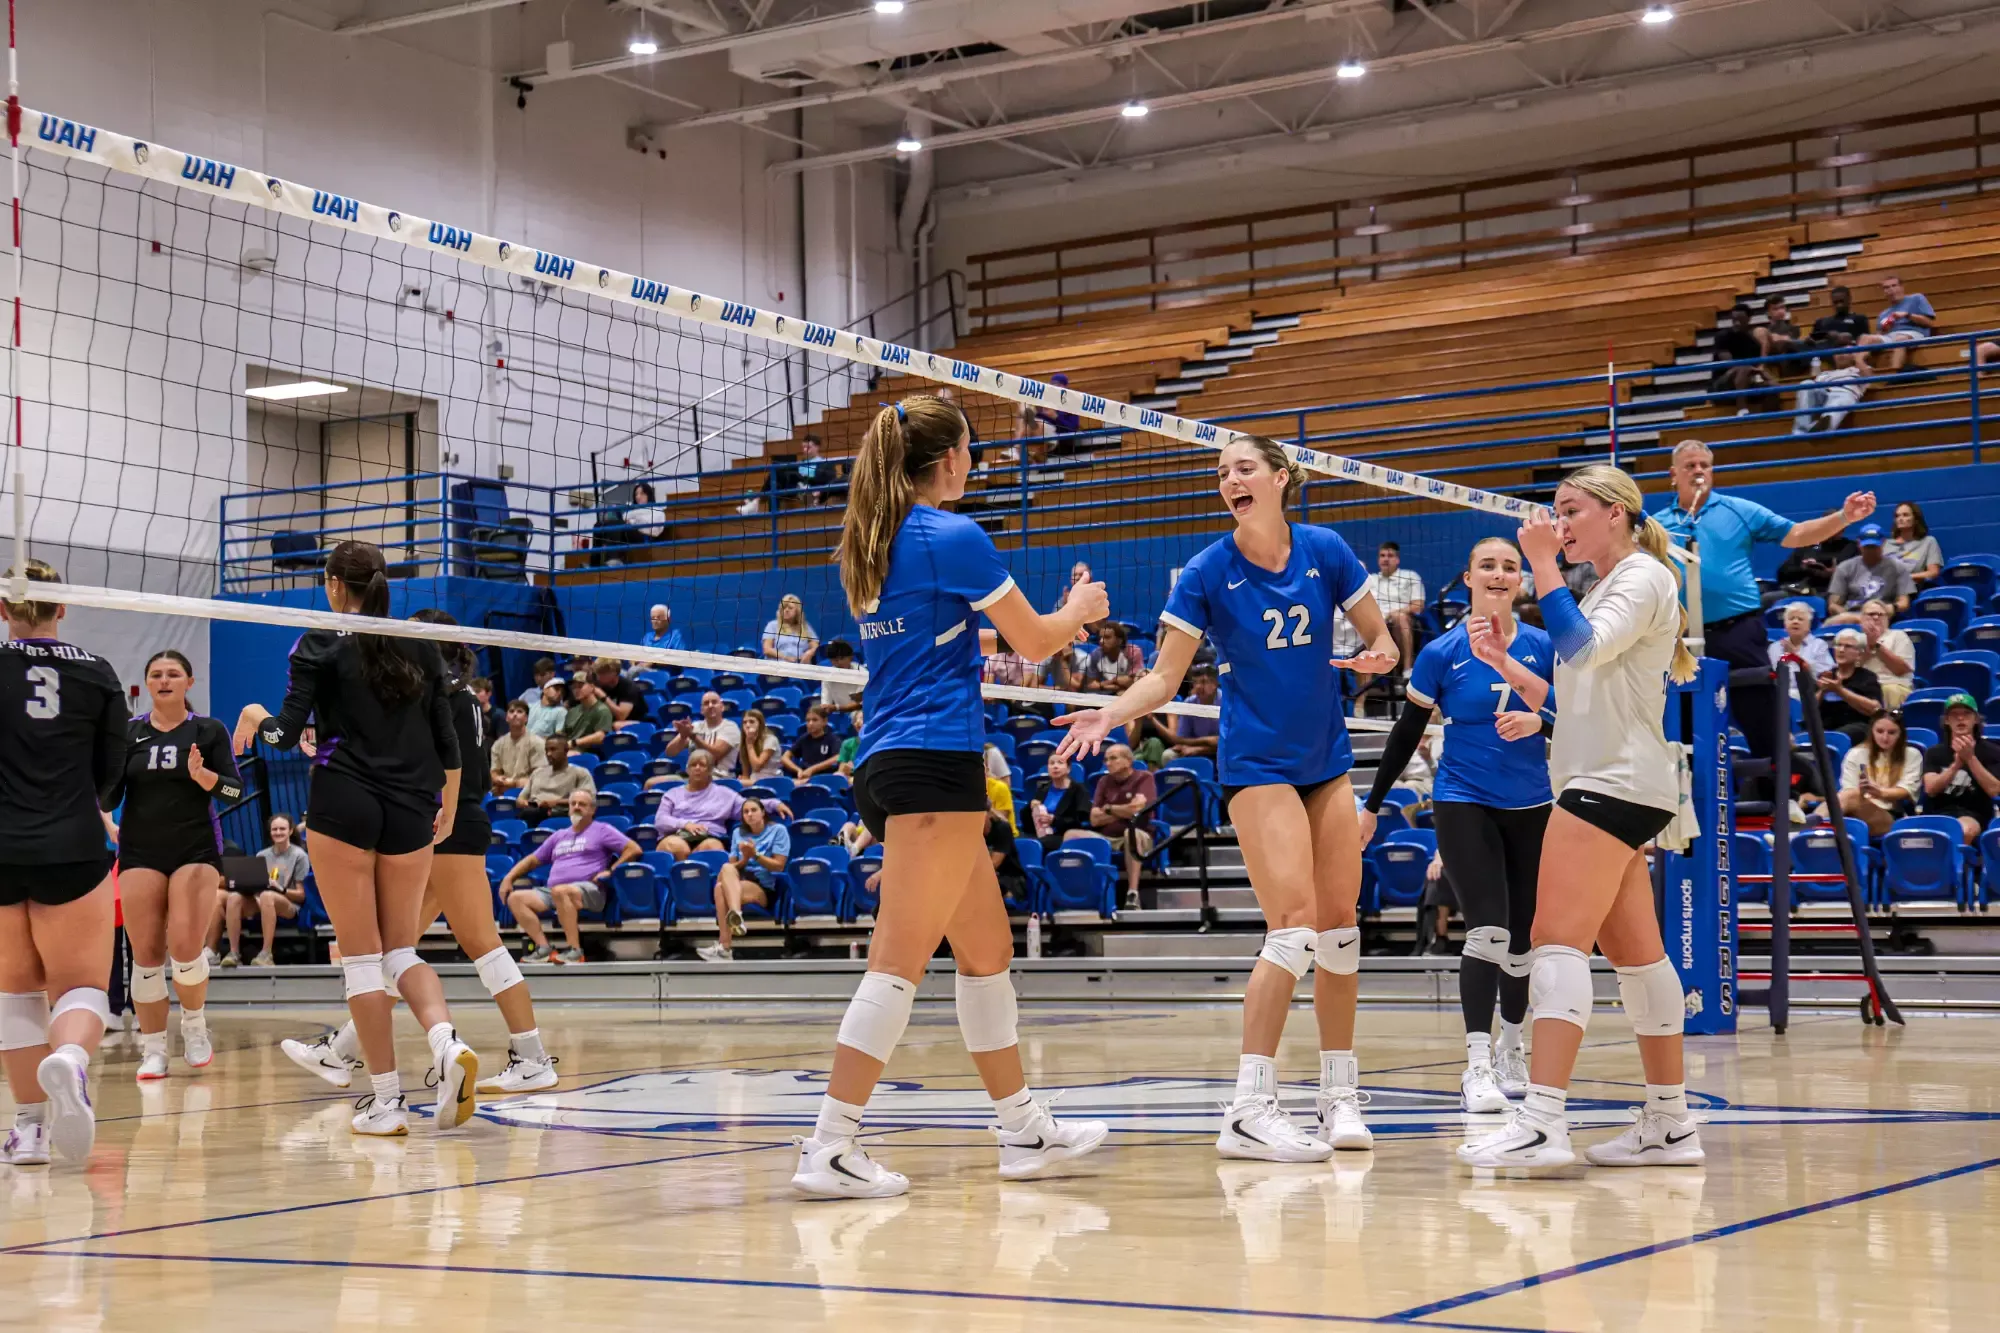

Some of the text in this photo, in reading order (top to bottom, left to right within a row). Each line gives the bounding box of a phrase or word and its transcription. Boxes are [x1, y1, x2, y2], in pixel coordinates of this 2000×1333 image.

[40, 115, 96, 152] UAH
[182, 156, 235, 188] UAH
[312, 191, 358, 221] UAH
[428, 221, 473, 252] UAH
[535, 252, 574, 279] UAH
[630, 276, 670, 306] UAH
[721, 302, 756, 326] UAH
[802, 323, 837, 348] UAH
[880, 342, 911, 366] UAH
[951, 360, 981, 383] UAH
[1018, 378, 1046, 400] UAH
[1082, 393, 1106, 415] UAH
[1140, 409, 1163, 429] UAH
[1195, 422, 1217, 442] UAH
[1296, 448, 1315, 466] UAH
[1342, 459, 1360, 476] UAH
[1386, 470, 1404, 486] UAH
[1428, 479, 1445, 495] UAH
[1467, 488, 1484, 504] UAH
[1262, 604, 1312, 650] 22
[50, 645, 97, 662] HILL
[26, 665, 61, 720] 3
[1490, 682, 1511, 714] 7
[147, 745, 178, 770] 13
[1716, 732, 1732, 1015] CHARGERS
[1680, 878, 1694, 970] sports imports
